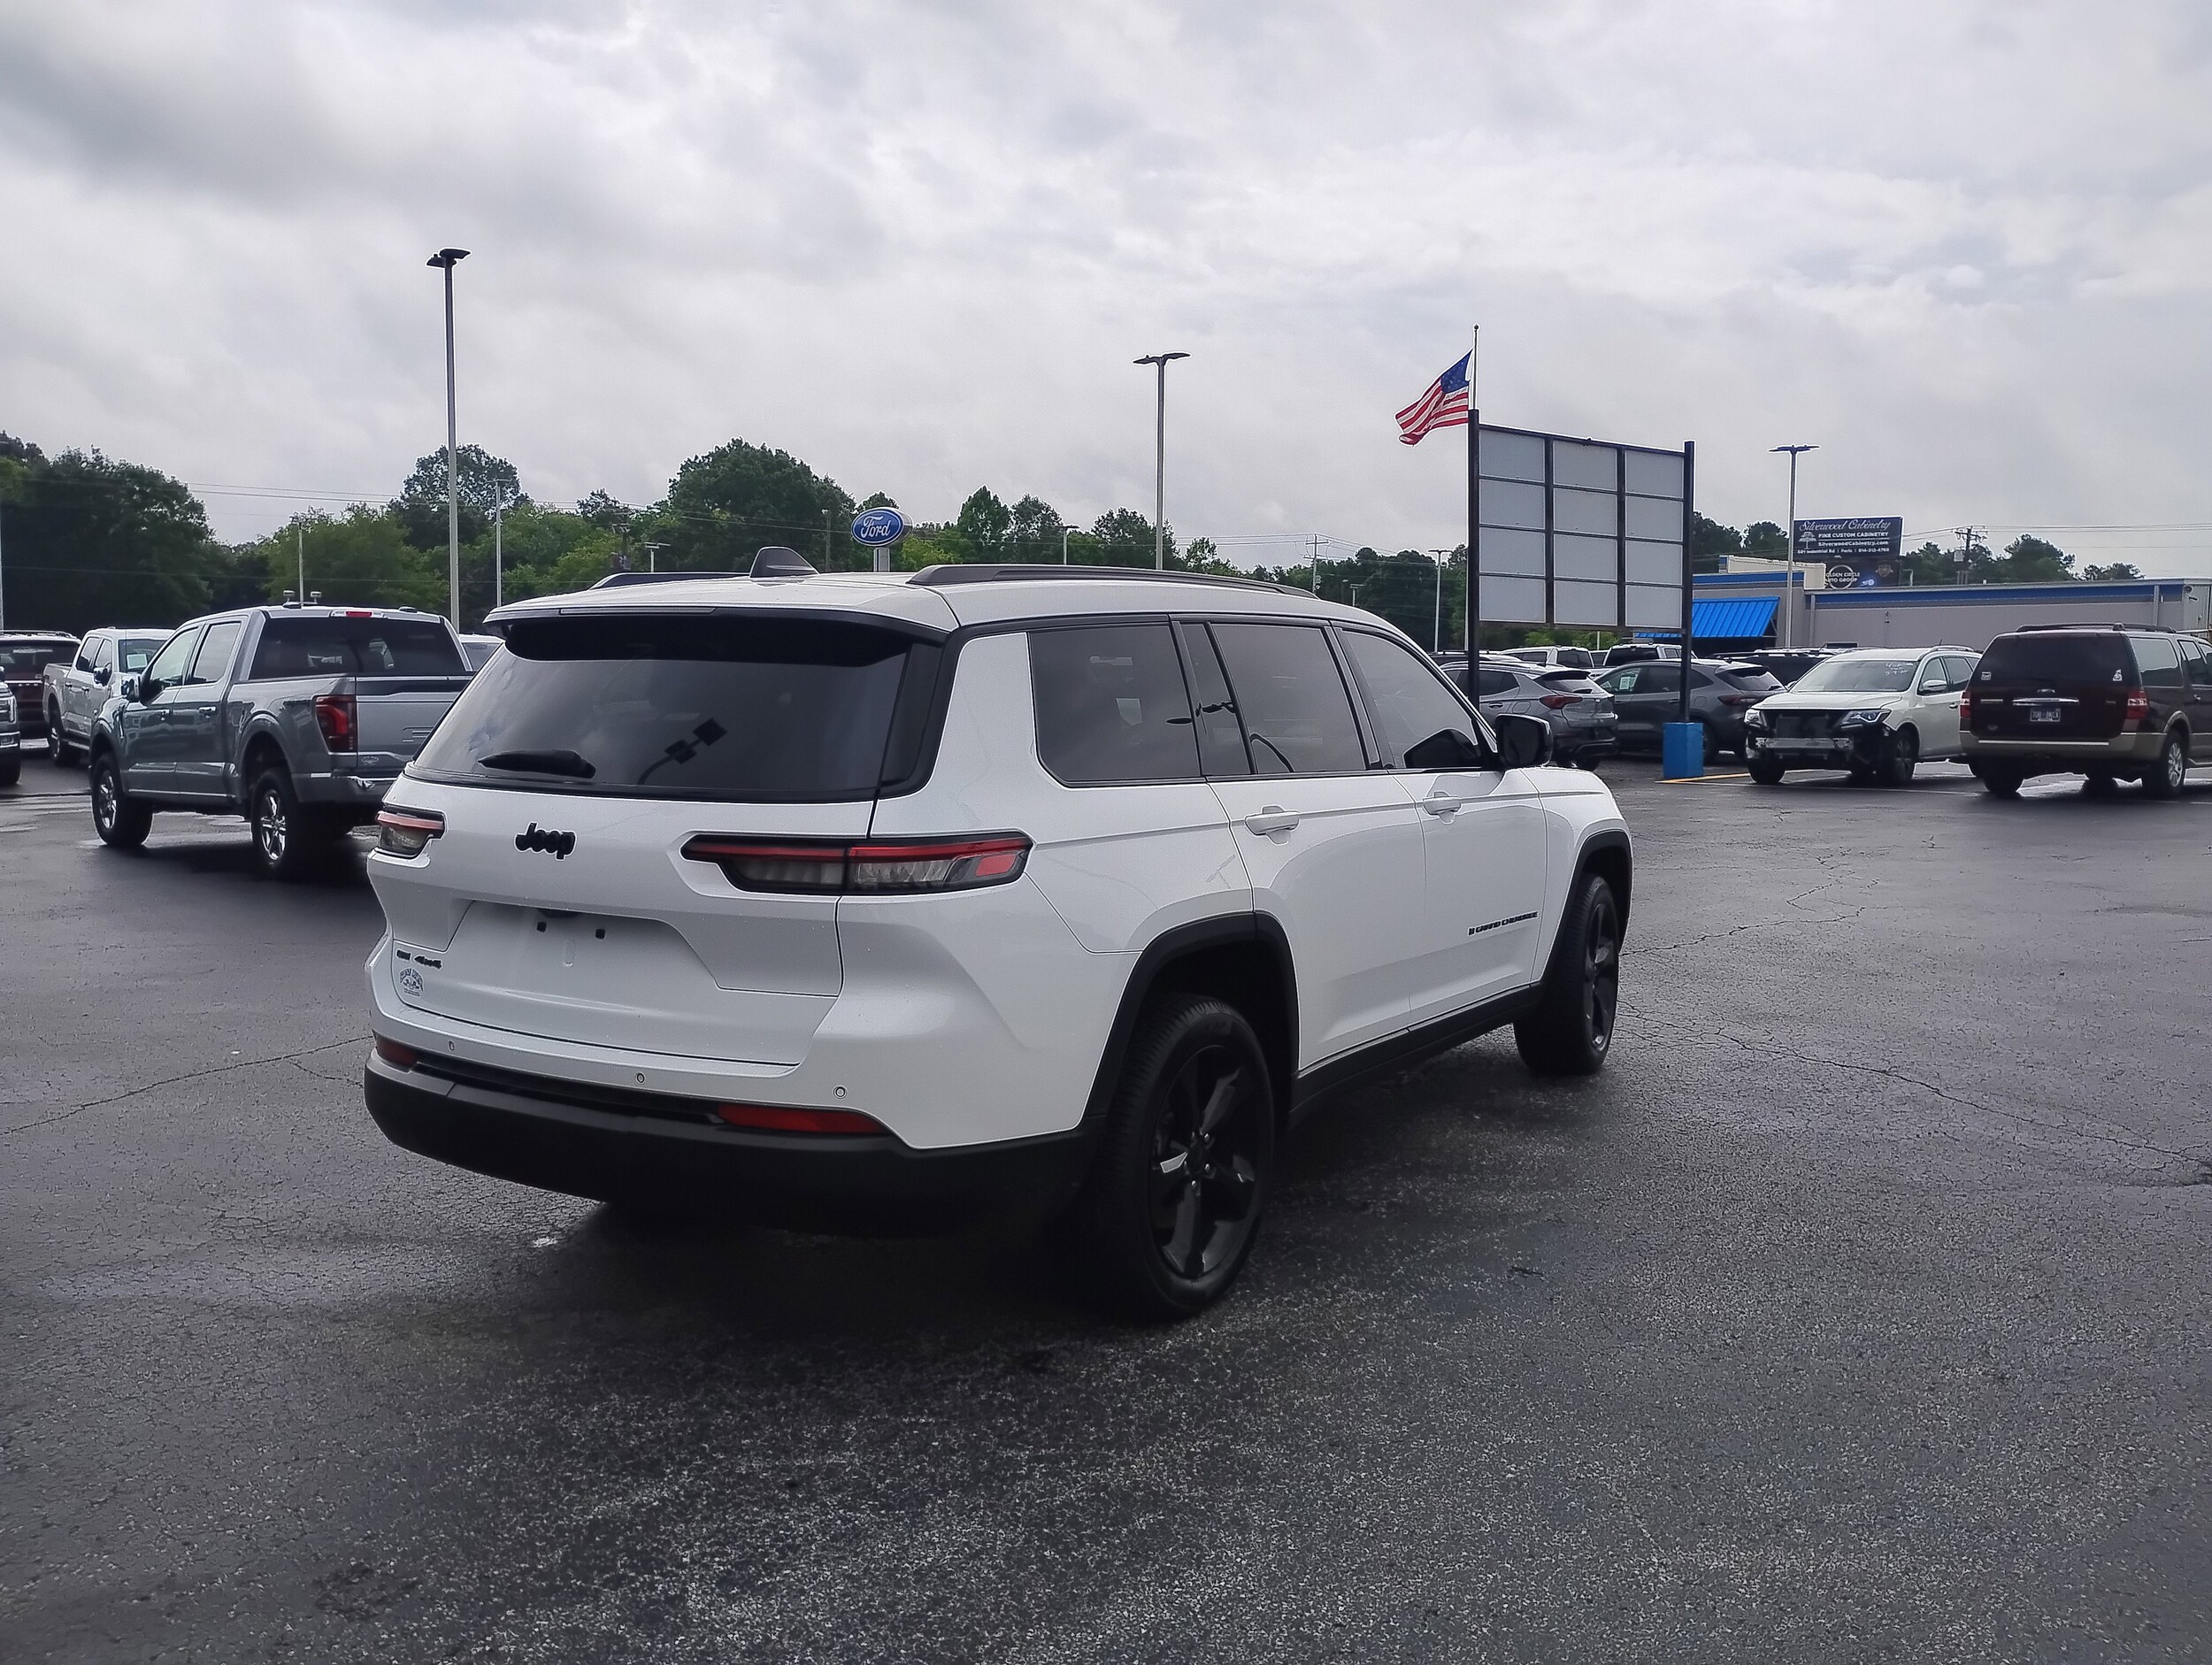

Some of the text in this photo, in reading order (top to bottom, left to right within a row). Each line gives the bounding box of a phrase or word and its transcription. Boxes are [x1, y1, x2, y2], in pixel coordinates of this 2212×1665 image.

[860, 516, 892, 538] Ford
[1799, 518, 1891, 531] Silverwood Cabinetry
[1476, 921, 1501, 932] GRAND
[1502, 911, 1538, 925] CHEROKEE
